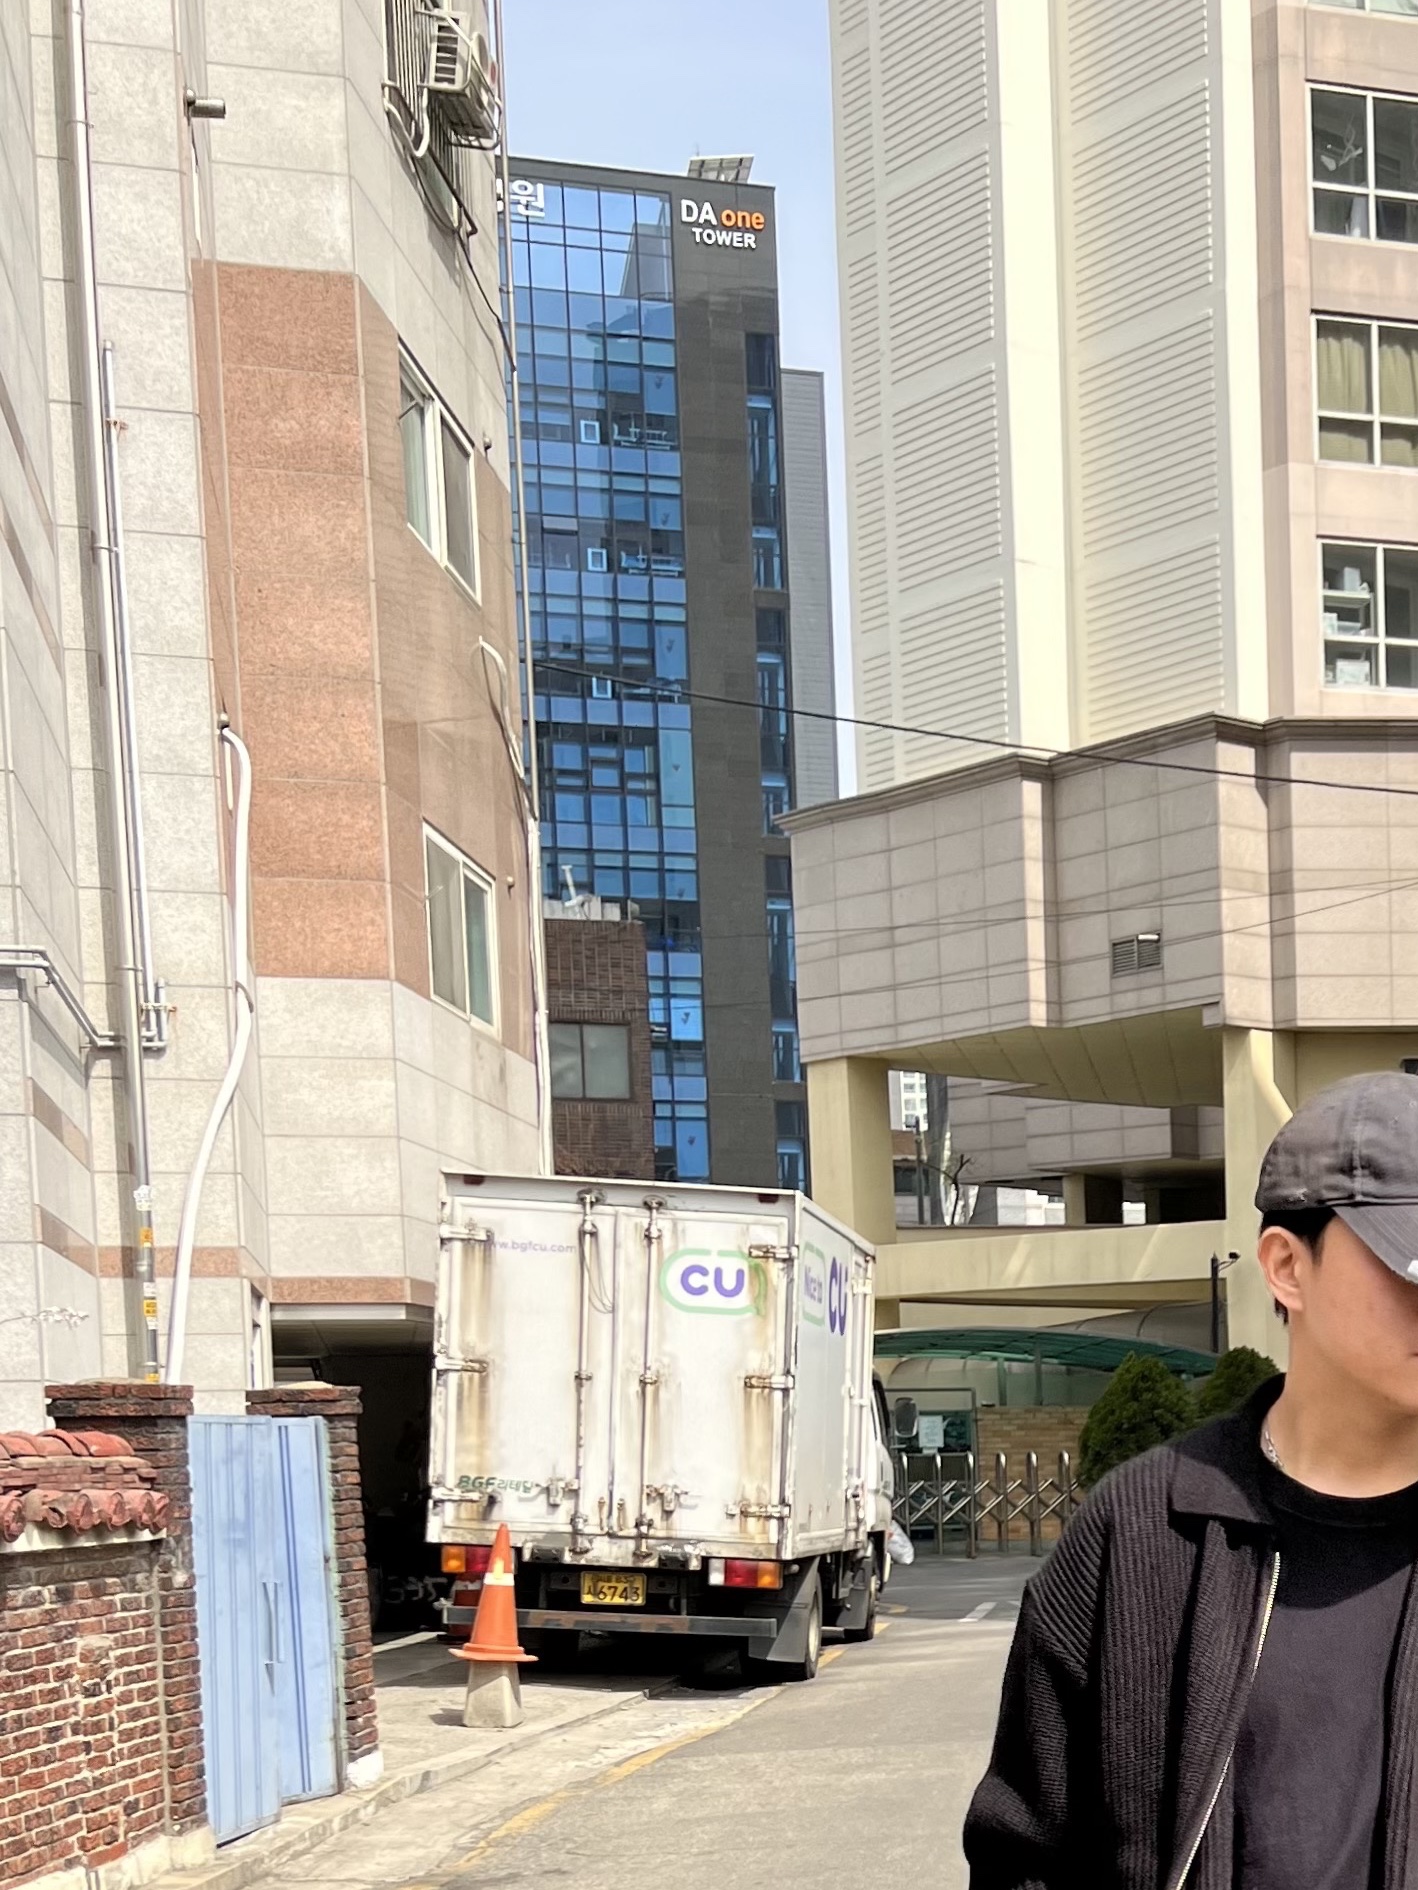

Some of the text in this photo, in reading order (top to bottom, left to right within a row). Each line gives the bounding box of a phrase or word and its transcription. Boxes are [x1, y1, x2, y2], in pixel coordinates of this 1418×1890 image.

[680, 199, 765, 231] DA one
[691, 226, 757, 250] TOWER
[680, 1263, 745, 1298] CU
[829, 1255, 848, 1337] CU
[598, 1585, 640, 1602] 6743
